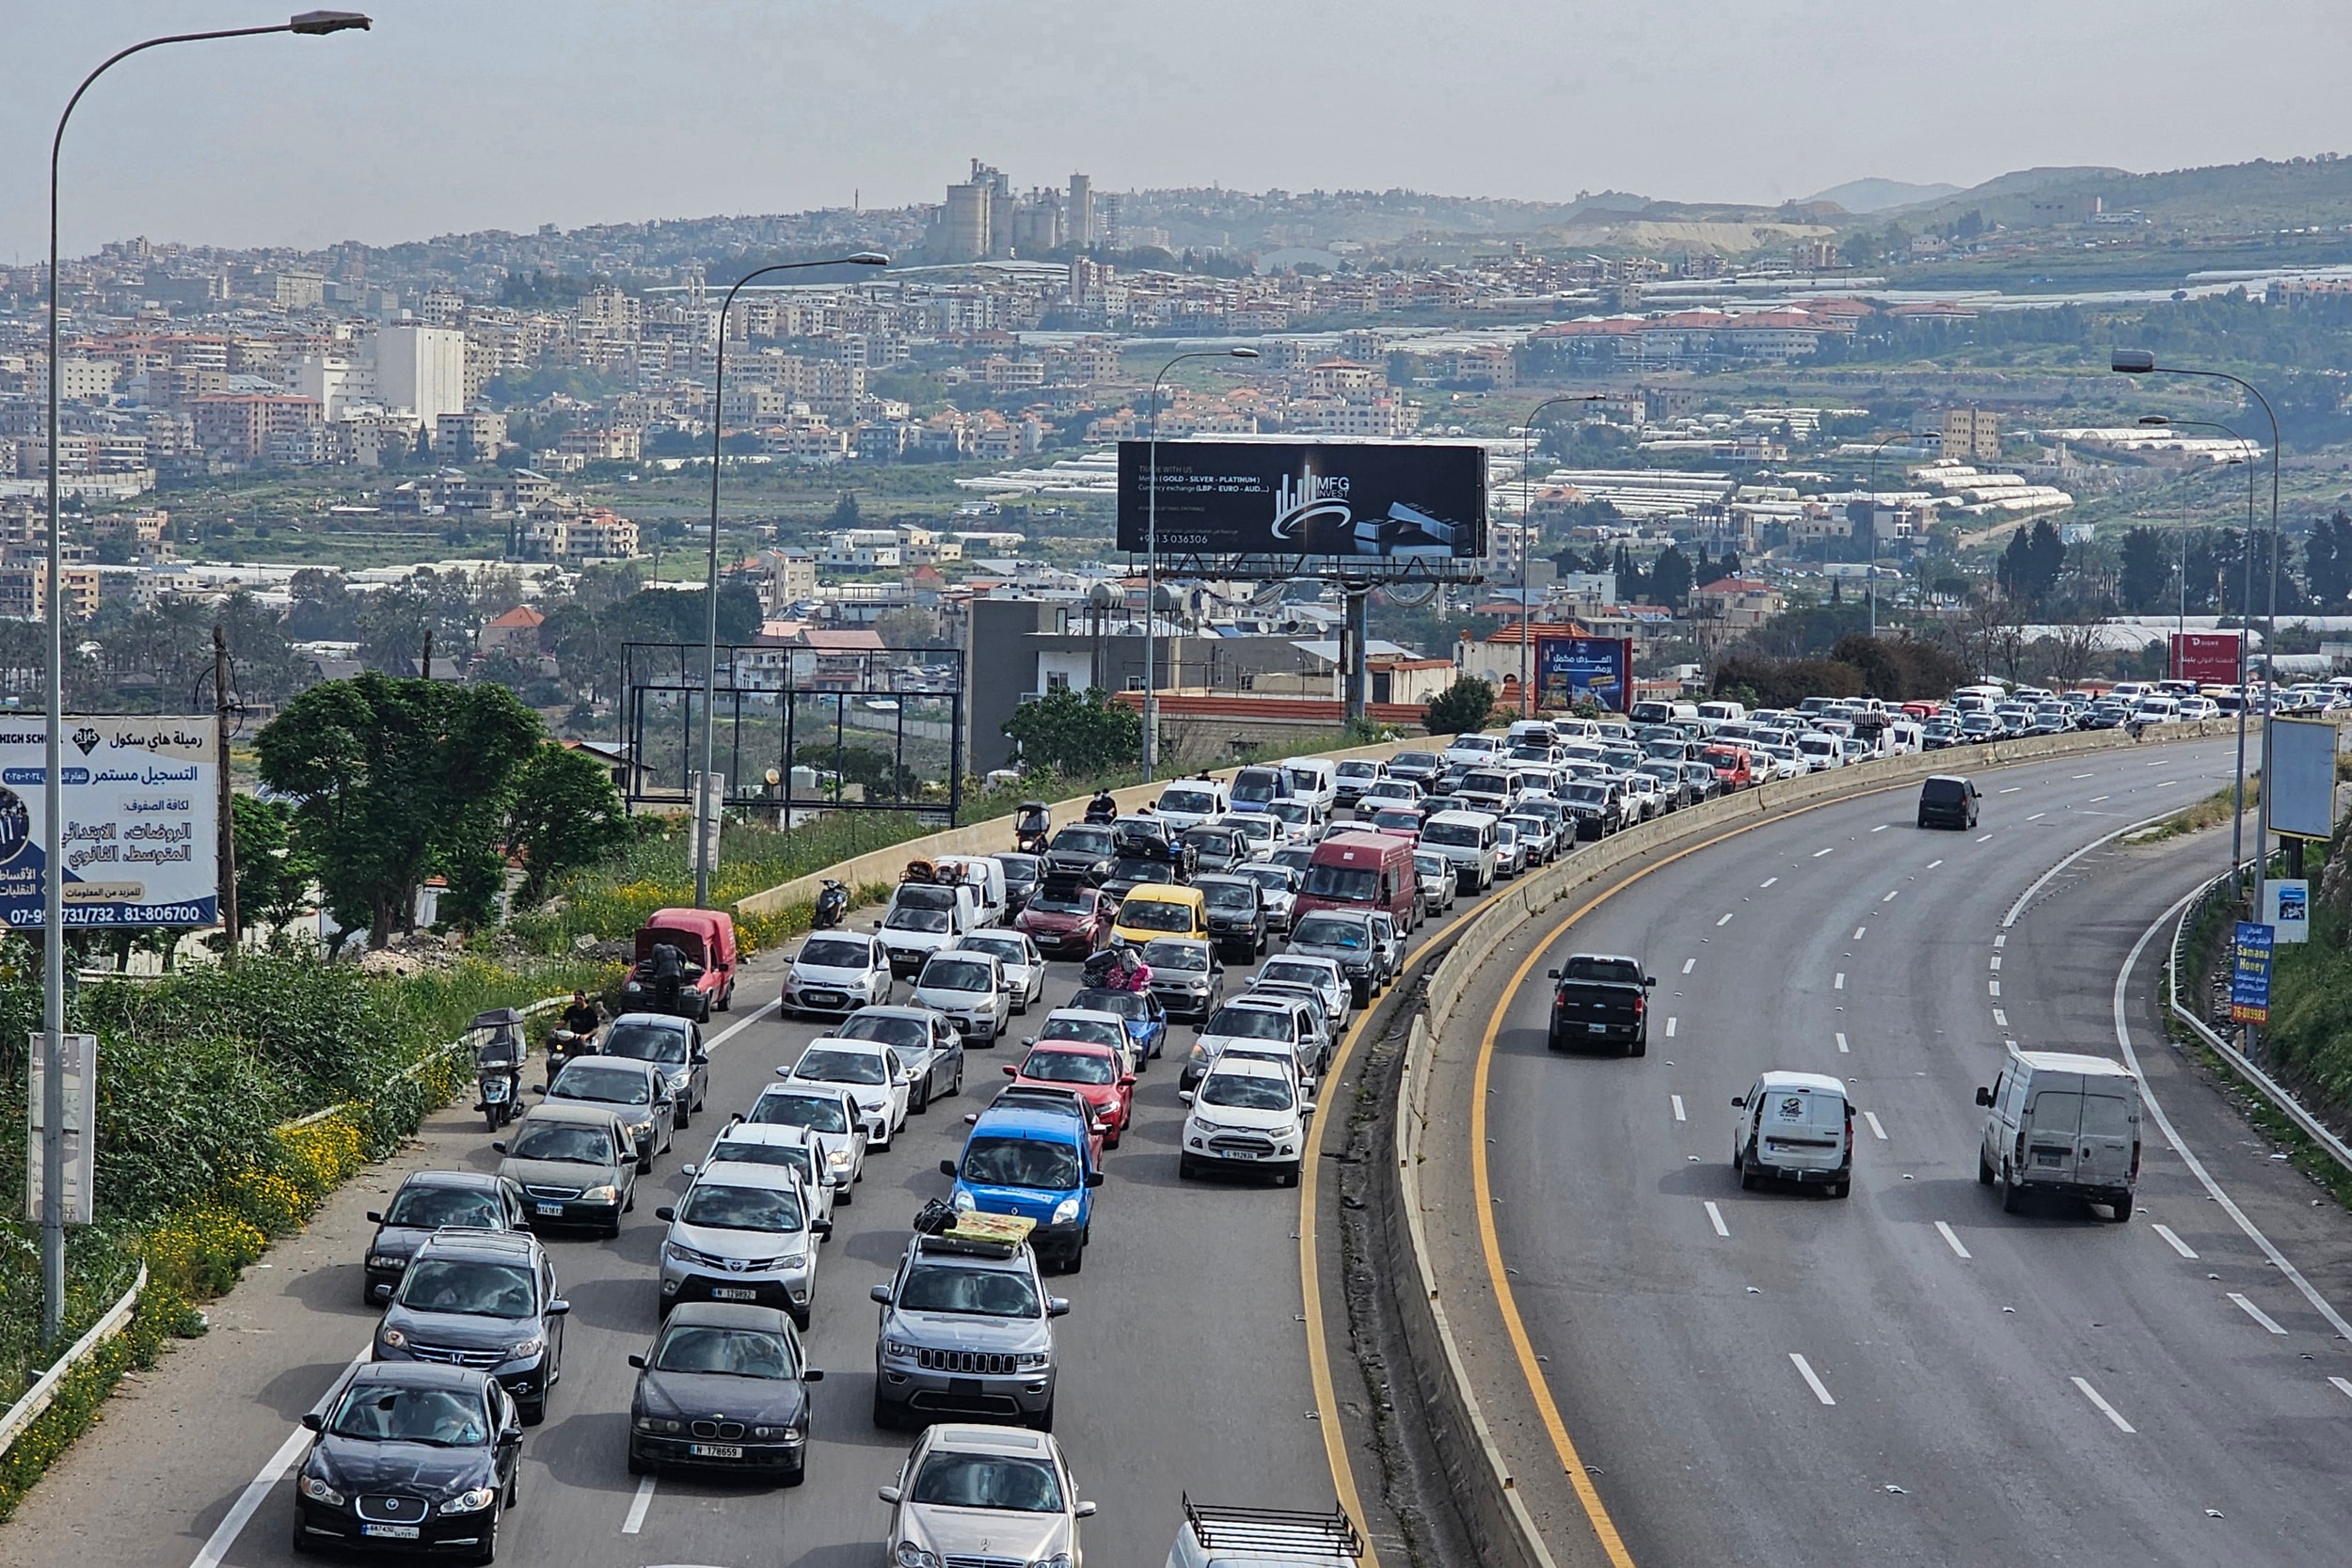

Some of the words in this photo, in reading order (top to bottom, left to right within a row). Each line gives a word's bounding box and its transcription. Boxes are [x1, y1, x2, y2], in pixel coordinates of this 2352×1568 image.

[1317, 476, 1350, 490] MFG
[1317, 489, 1348, 498] INVEST
[1163, 534, 1168, 543] 3
[1170, 534, 1208, 544] 036306
[110, 732, 145, 749] سكول
[148, 732, 170, 752] هاي
[173, 731, 202, 749] رميلة
[92, 768, 138, 785] مستمر
[141, 766, 198, 784] التسجيل
[167, 799, 189, 810] لكافة
[69, 845, 119, 870] الثانوي
[65, 888, 103, 898] المعلومات
[104, 890, 117, 898] من
[118, 888, 141, 897] للمزيد
[124, 906, 199, 921] 81-806700
[2237, 944, 2269, 959] Samana
[2239, 958, 2265, 975] Honey
[697, 1445, 703, 1454] N
